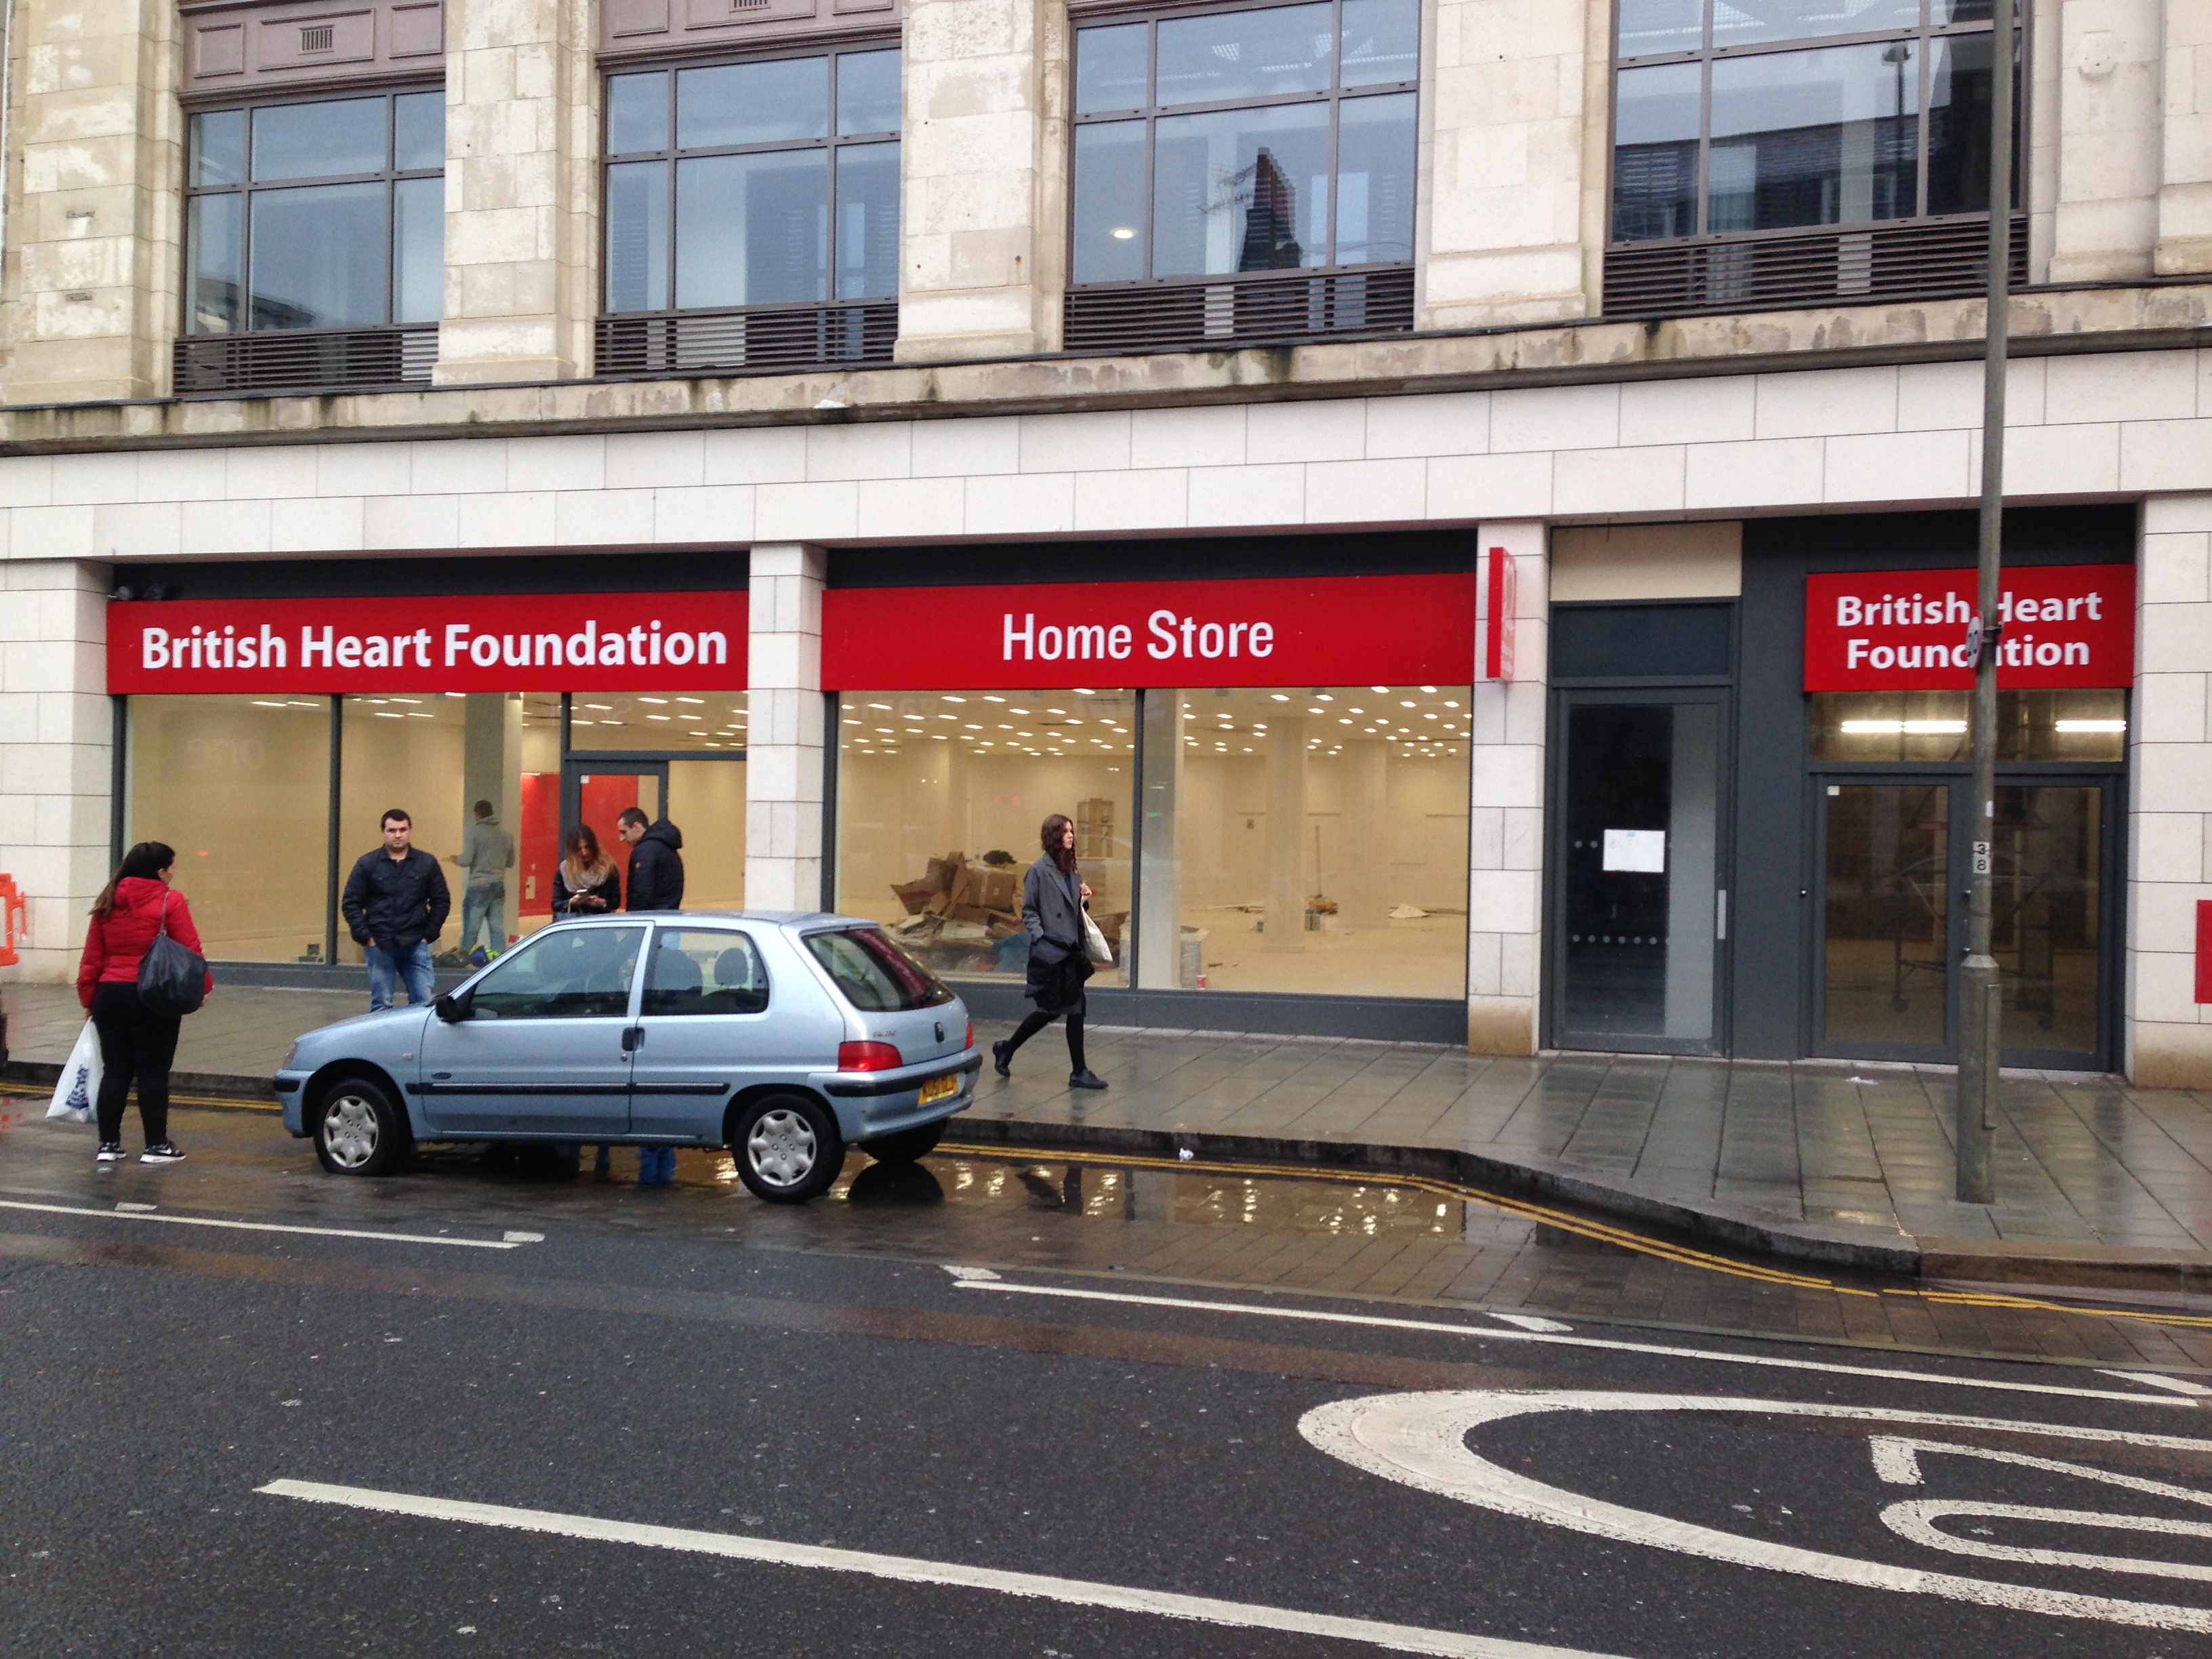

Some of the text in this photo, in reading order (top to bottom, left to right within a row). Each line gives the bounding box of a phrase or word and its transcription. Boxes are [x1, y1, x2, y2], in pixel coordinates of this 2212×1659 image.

[1837, 591, 1970, 627] British
[142, 619, 727, 670] British Heart Foundation
[1003, 609, 1274, 661] Home Store
[1847, 634, 2089, 670] Fountion
